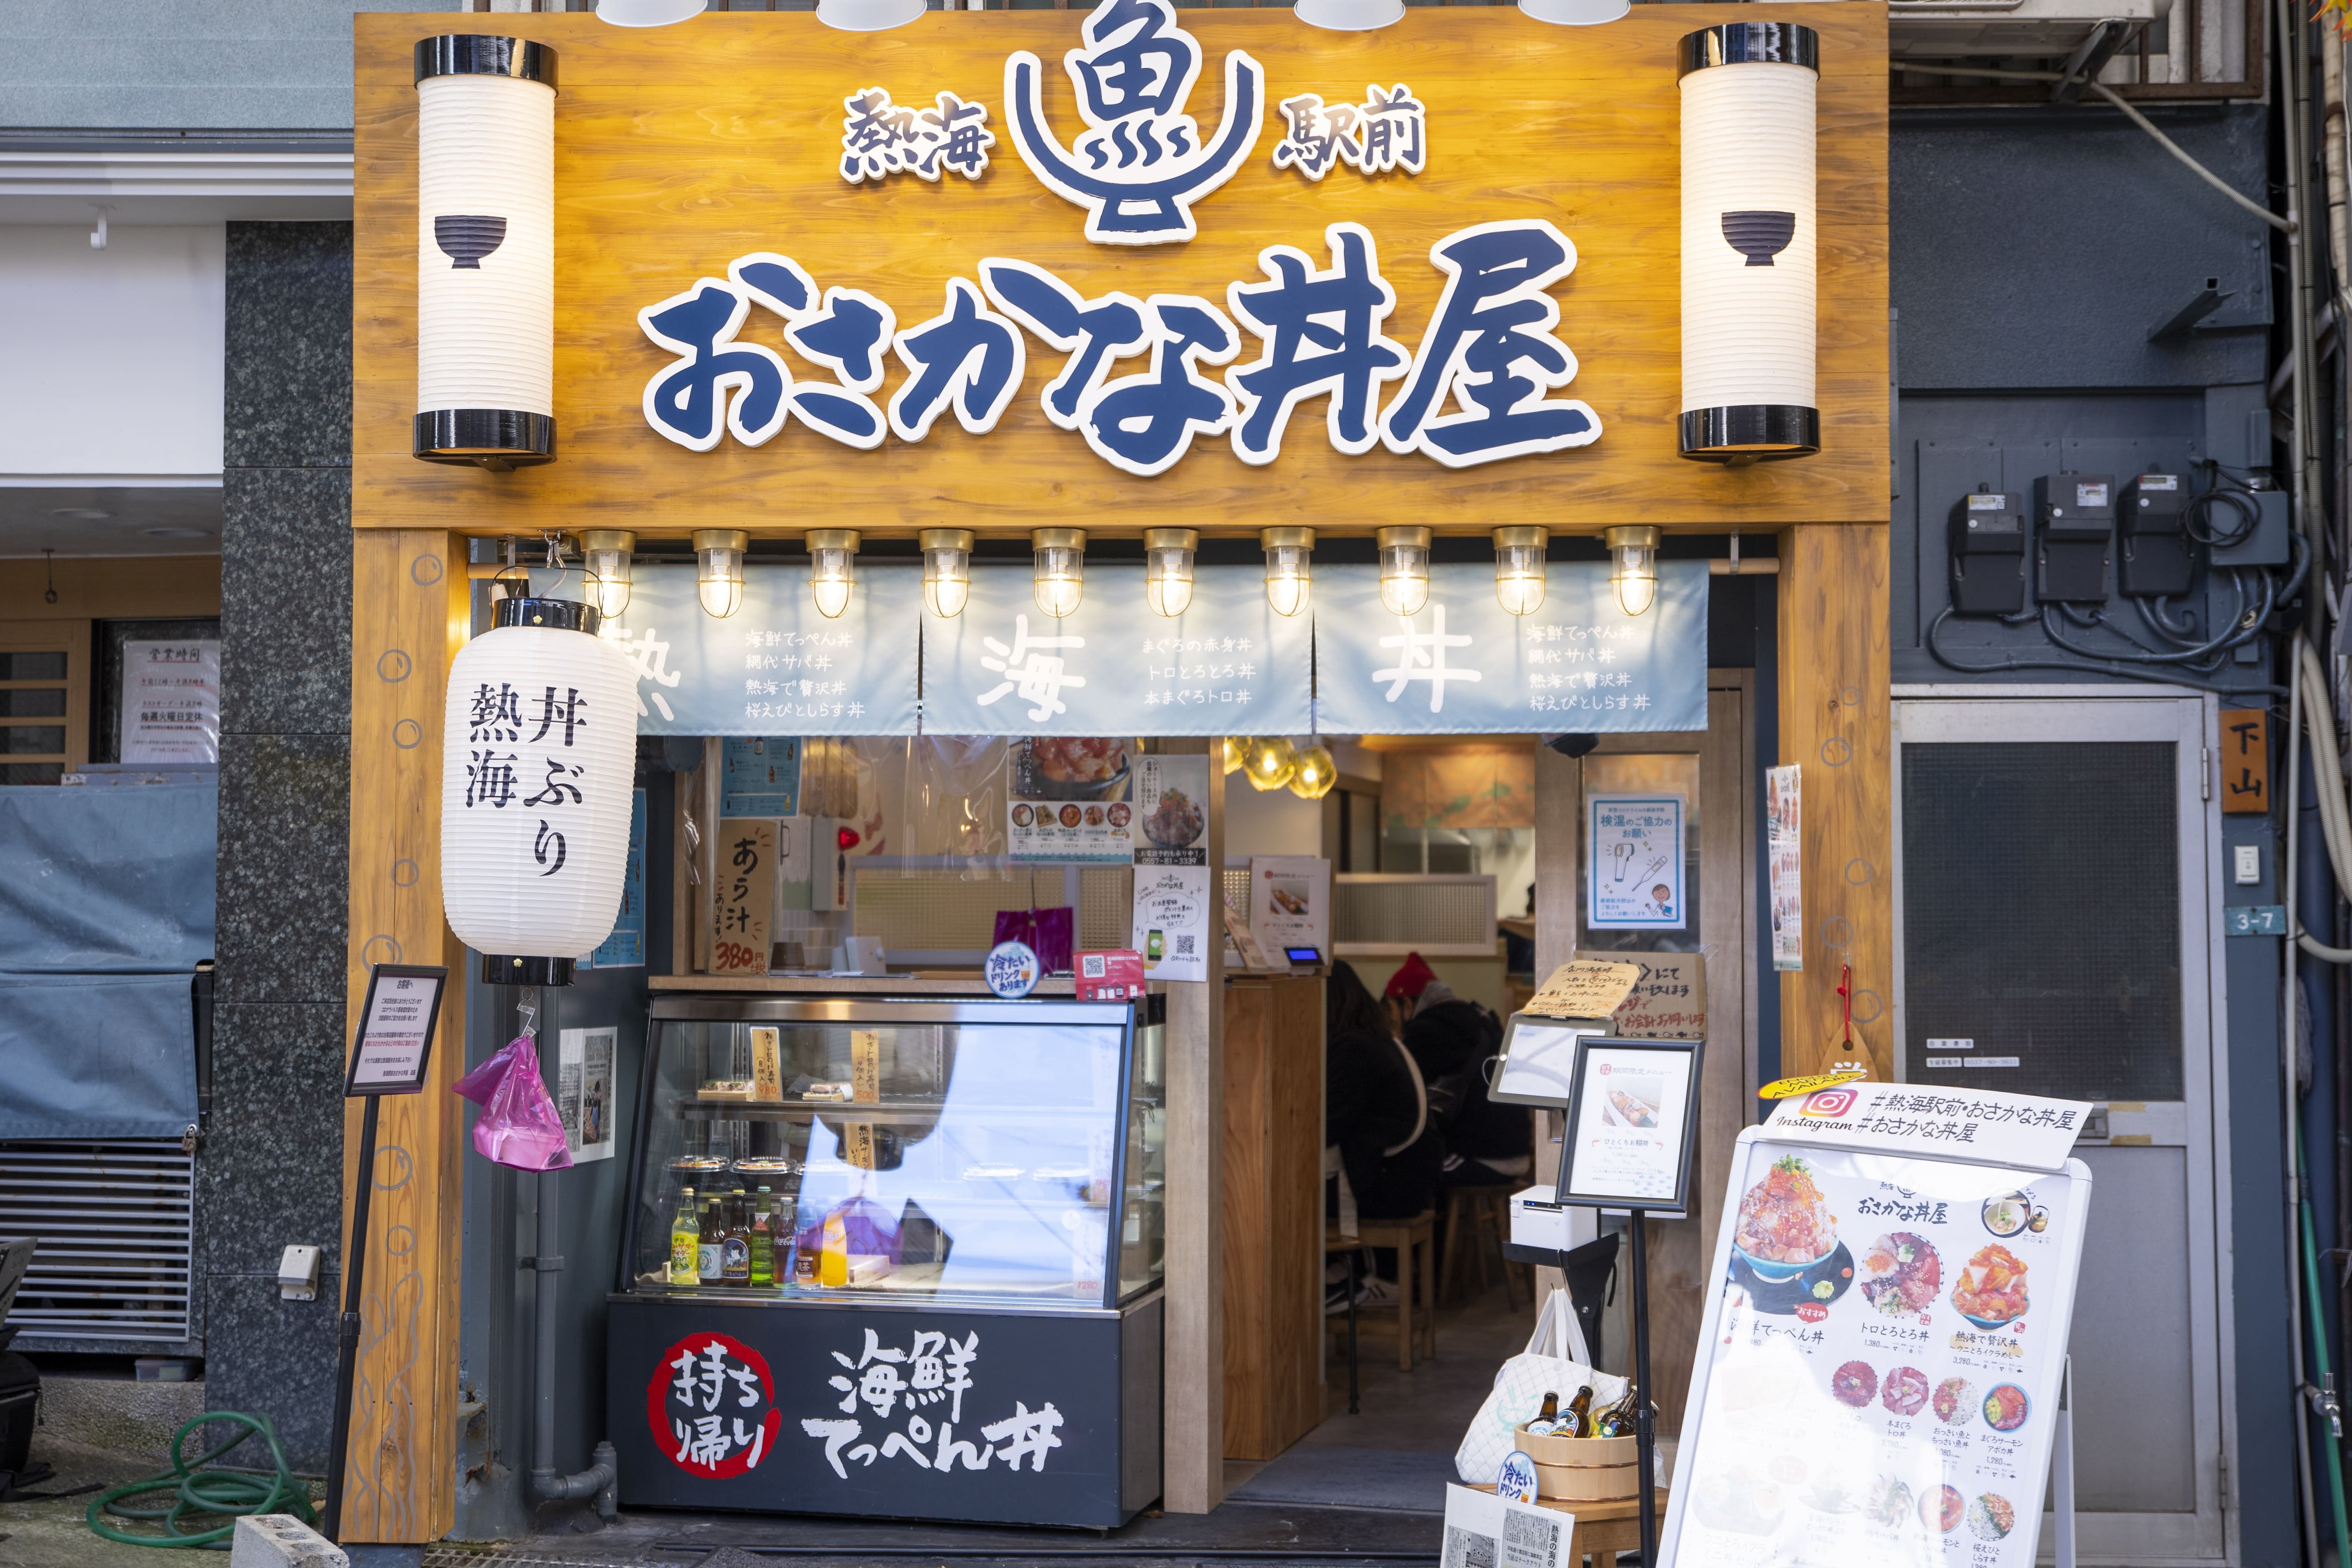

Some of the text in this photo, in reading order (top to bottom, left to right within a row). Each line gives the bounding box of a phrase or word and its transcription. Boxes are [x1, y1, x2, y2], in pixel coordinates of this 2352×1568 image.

[841, 85, 1425, 181] 熱海 駅前
[641, 221, 1602, 475] おさかな丼屋
[745, 629, 853, 648] 海鮮てっぺん丼
[1526, 623, 1635, 642] 海鮮てっぺん丼
[1143, 637, 1253, 653] まぐろの赤身丼
[150, 648, 200, 661] 営業時間
[745, 654, 833, 672] 網代サバ丼
[1372, 604, 1482, 713] 丼
[977, 614, 1086, 722] 海
[1149, 663, 1256, 680] トロとろとろ丼
[745, 679, 847, 697] 熱海で贅沢丼
[1529, 673, 1632, 690] 熱海で贅沢丼
[1145, 690, 1252, 705] 本まぐろトロ丼
[1530, 694, 1651, 711] 桜えびとしらす丼
[745, 702, 865, 719] 桜えびとしらす丼
[466, 683, 522, 808] 熱海
[2229, 723, 2262, 798] 下山
[524, 686, 587, 877] 丼ぶり
[1601, 815, 1673, 827] 検温のご協力の
[1622, 828, 1652, 839] お願い
[726, 838, 758, 933] あら汁
[2237, 912, 2273, 930] 3-7
[990, 953, 1030, 972] 冷たい
[991, 970, 1020, 983] ドリンク
[999, 978, 1029, 992] あります
[1612, 1067, 1673, 1076] 期間限定メニュー
[1777, 1116, 1853, 1132] Instagram
[1854, 1112, 1979, 1143] #おさかな丼屋
[1604, 1138, 1649, 1147] ひとくちお稲荷
[1858, 1197, 1949, 1225] おさかな丼屋
[1798, 1307, 1826, 1318] おすすめ
[1861, 1322, 1929, 1343] トロとろとろ丼
[1955, 1330, 2018, 1349] 熱海で贅沢丼
[670, 1340, 758, 1412] 持ち
[828, 1328, 979, 1425] 海鮮
[1887, 1419, 1912, 1430] 本まぐろ
[1933, 1427, 1971, 1439] おっきい魚と
[801, 1401, 1064, 1479] てっぺん丼
[1887, 1429, 1906, 1439] トロ丼
[1932, 1436, 1969, 1449] ちっさい魚丼
[1980, 1434, 2023, 1447] まぐろサーモン
[676, 1415, 765, 1471] 帰り
[1987, 1446, 2014, 1456] アボカ丼
[1504, 1461, 1532, 1487] 冷たい
[1500, 1482, 1521, 1499] ドリンク
[1548, 1525, 1559, 1568] 熱海の海の
[1972, 1543, 2001, 1555] 桜えびと
[1972, 1553, 1997, 1565] しらす丼
